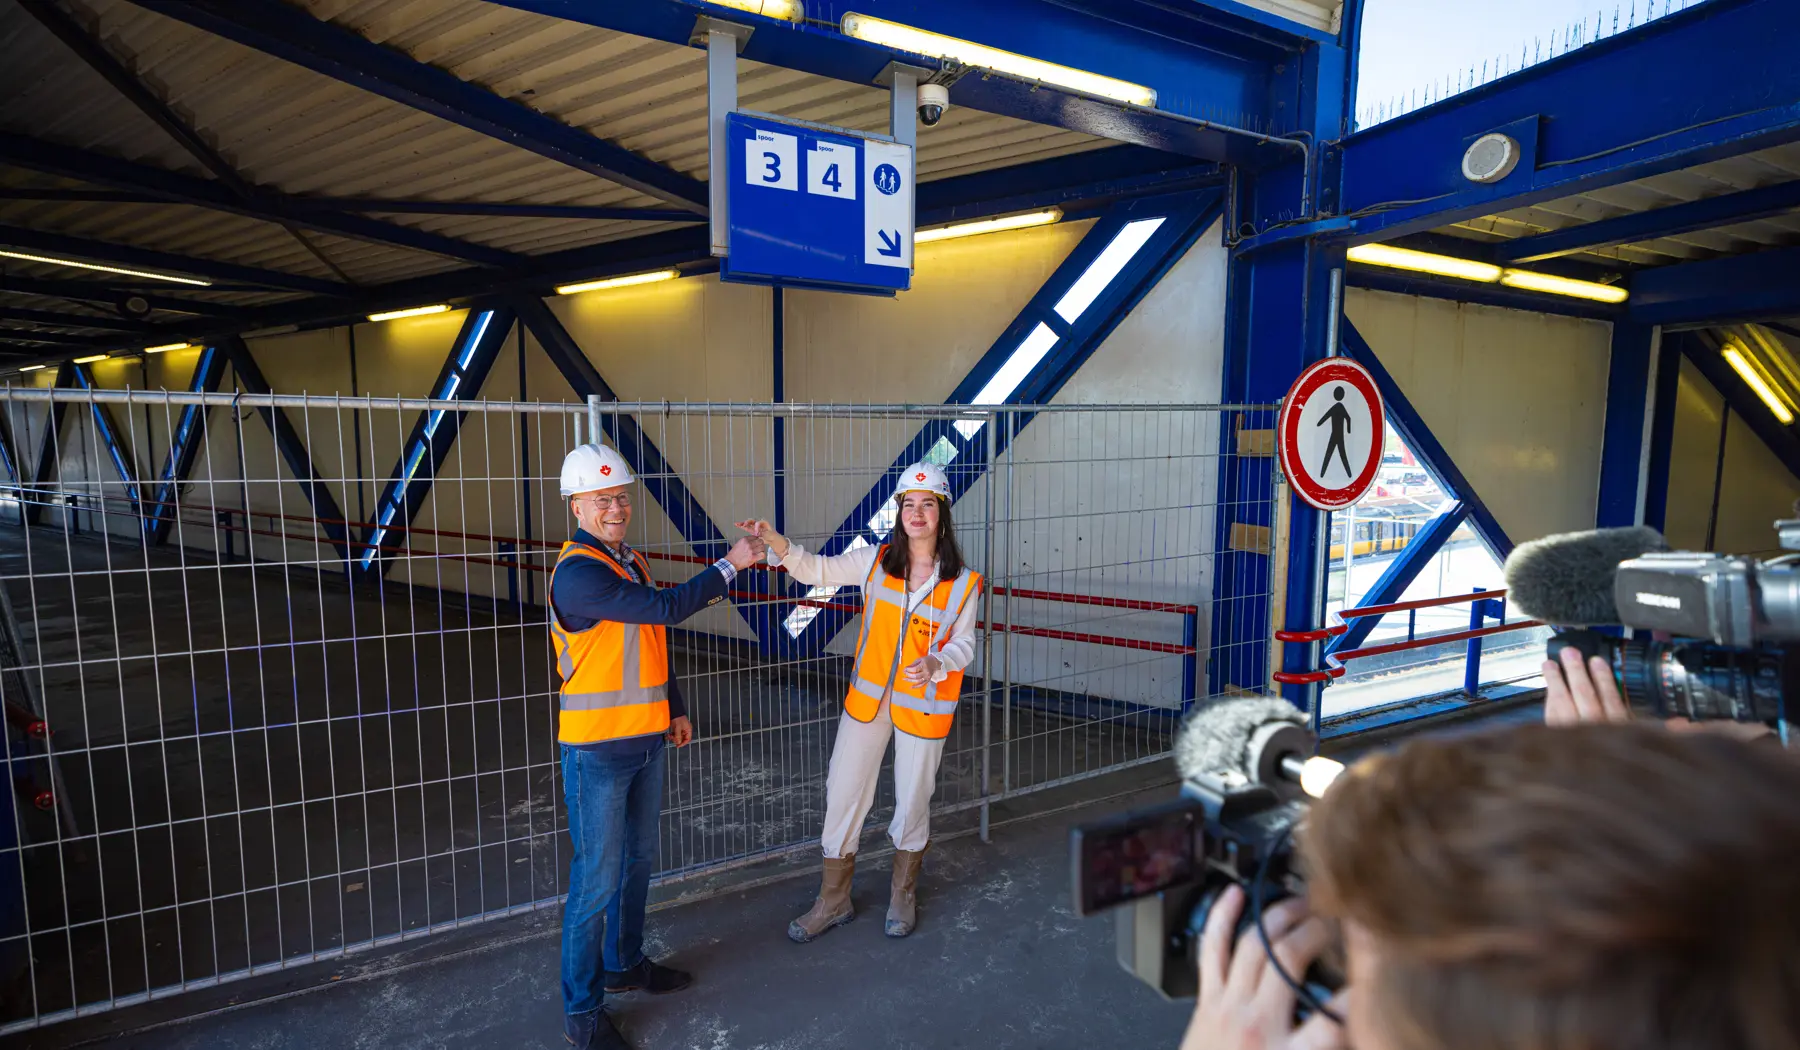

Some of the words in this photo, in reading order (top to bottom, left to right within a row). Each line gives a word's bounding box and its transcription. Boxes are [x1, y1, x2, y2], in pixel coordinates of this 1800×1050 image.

[758, 134, 775, 142] spoor
[818, 145, 834, 153] spoor
[763, 152, 782, 183] 3
[822, 163, 842, 193] 4
